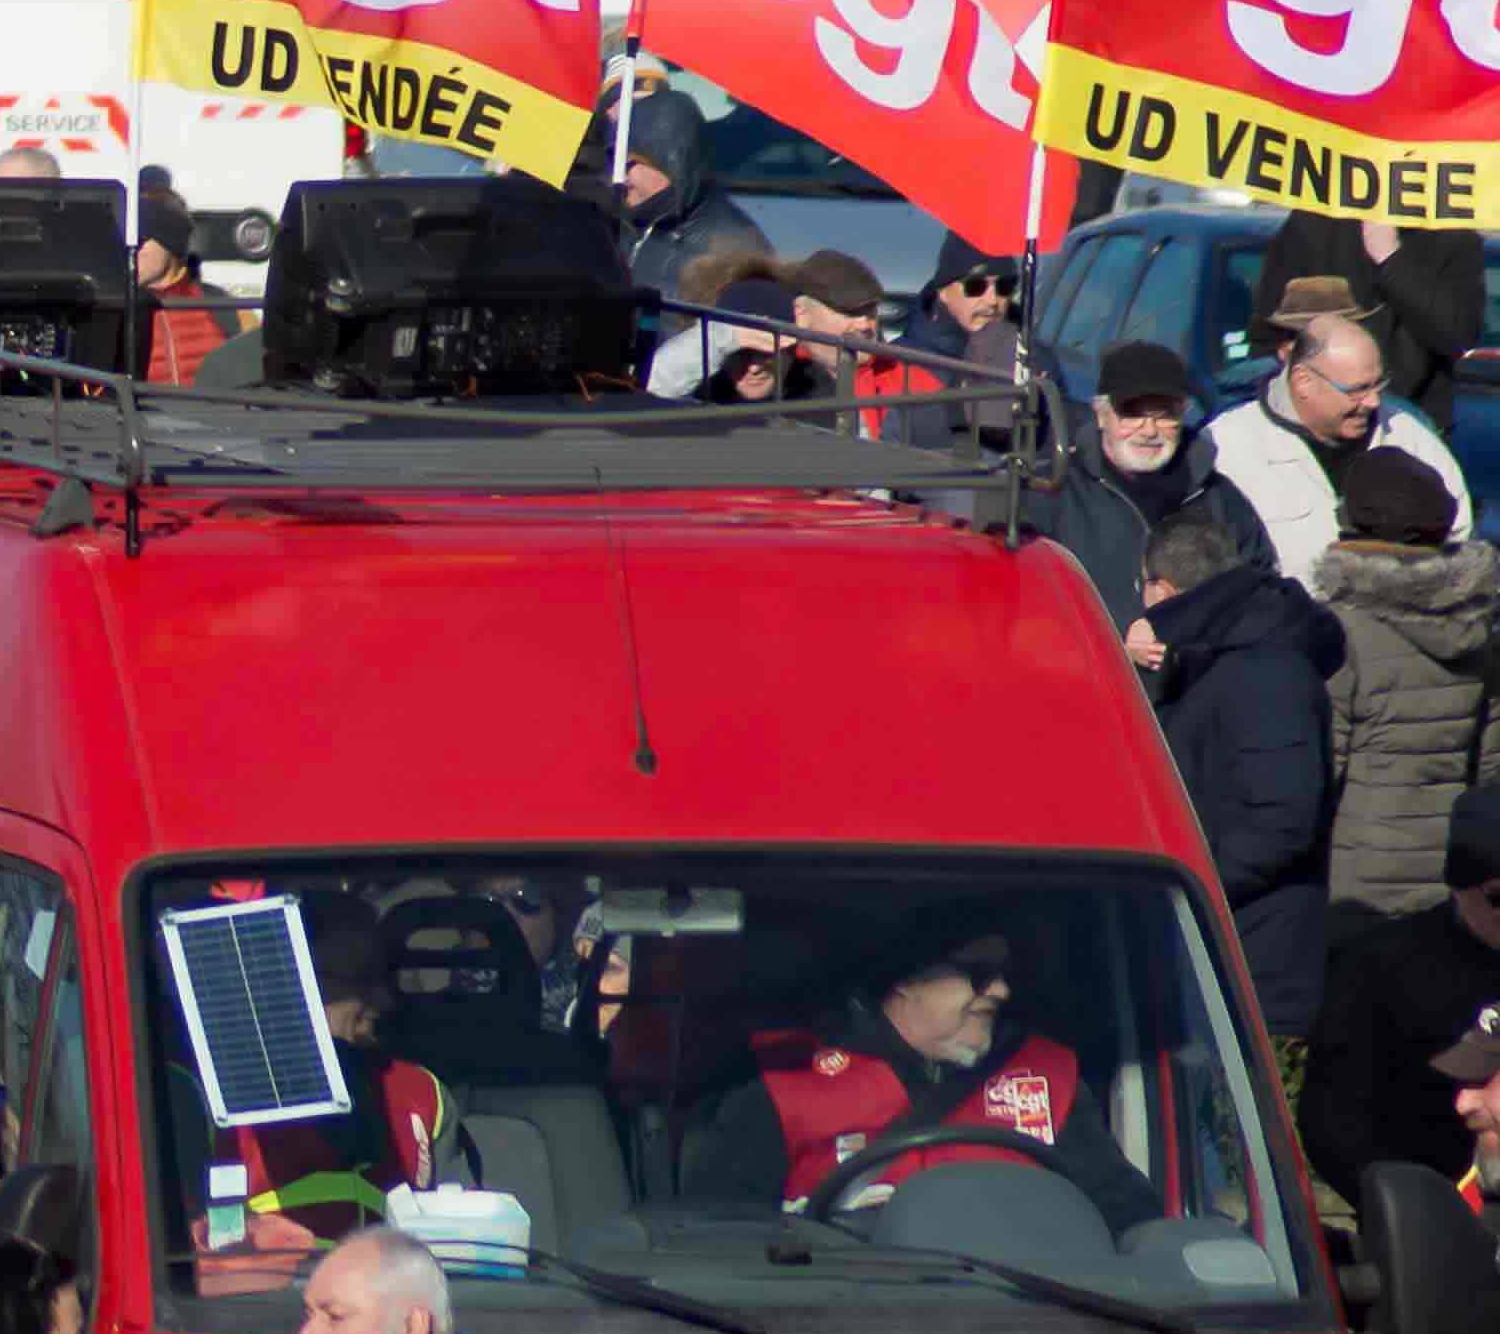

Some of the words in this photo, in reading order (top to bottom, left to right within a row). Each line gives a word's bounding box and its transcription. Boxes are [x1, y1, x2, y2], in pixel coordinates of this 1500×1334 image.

[208, 21, 300, 93] UD
[5, 113, 101, 134] SERVICE
[1085, 82, 1177, 161] UD
[1205, 112, 1477, 220] VENDÉE
